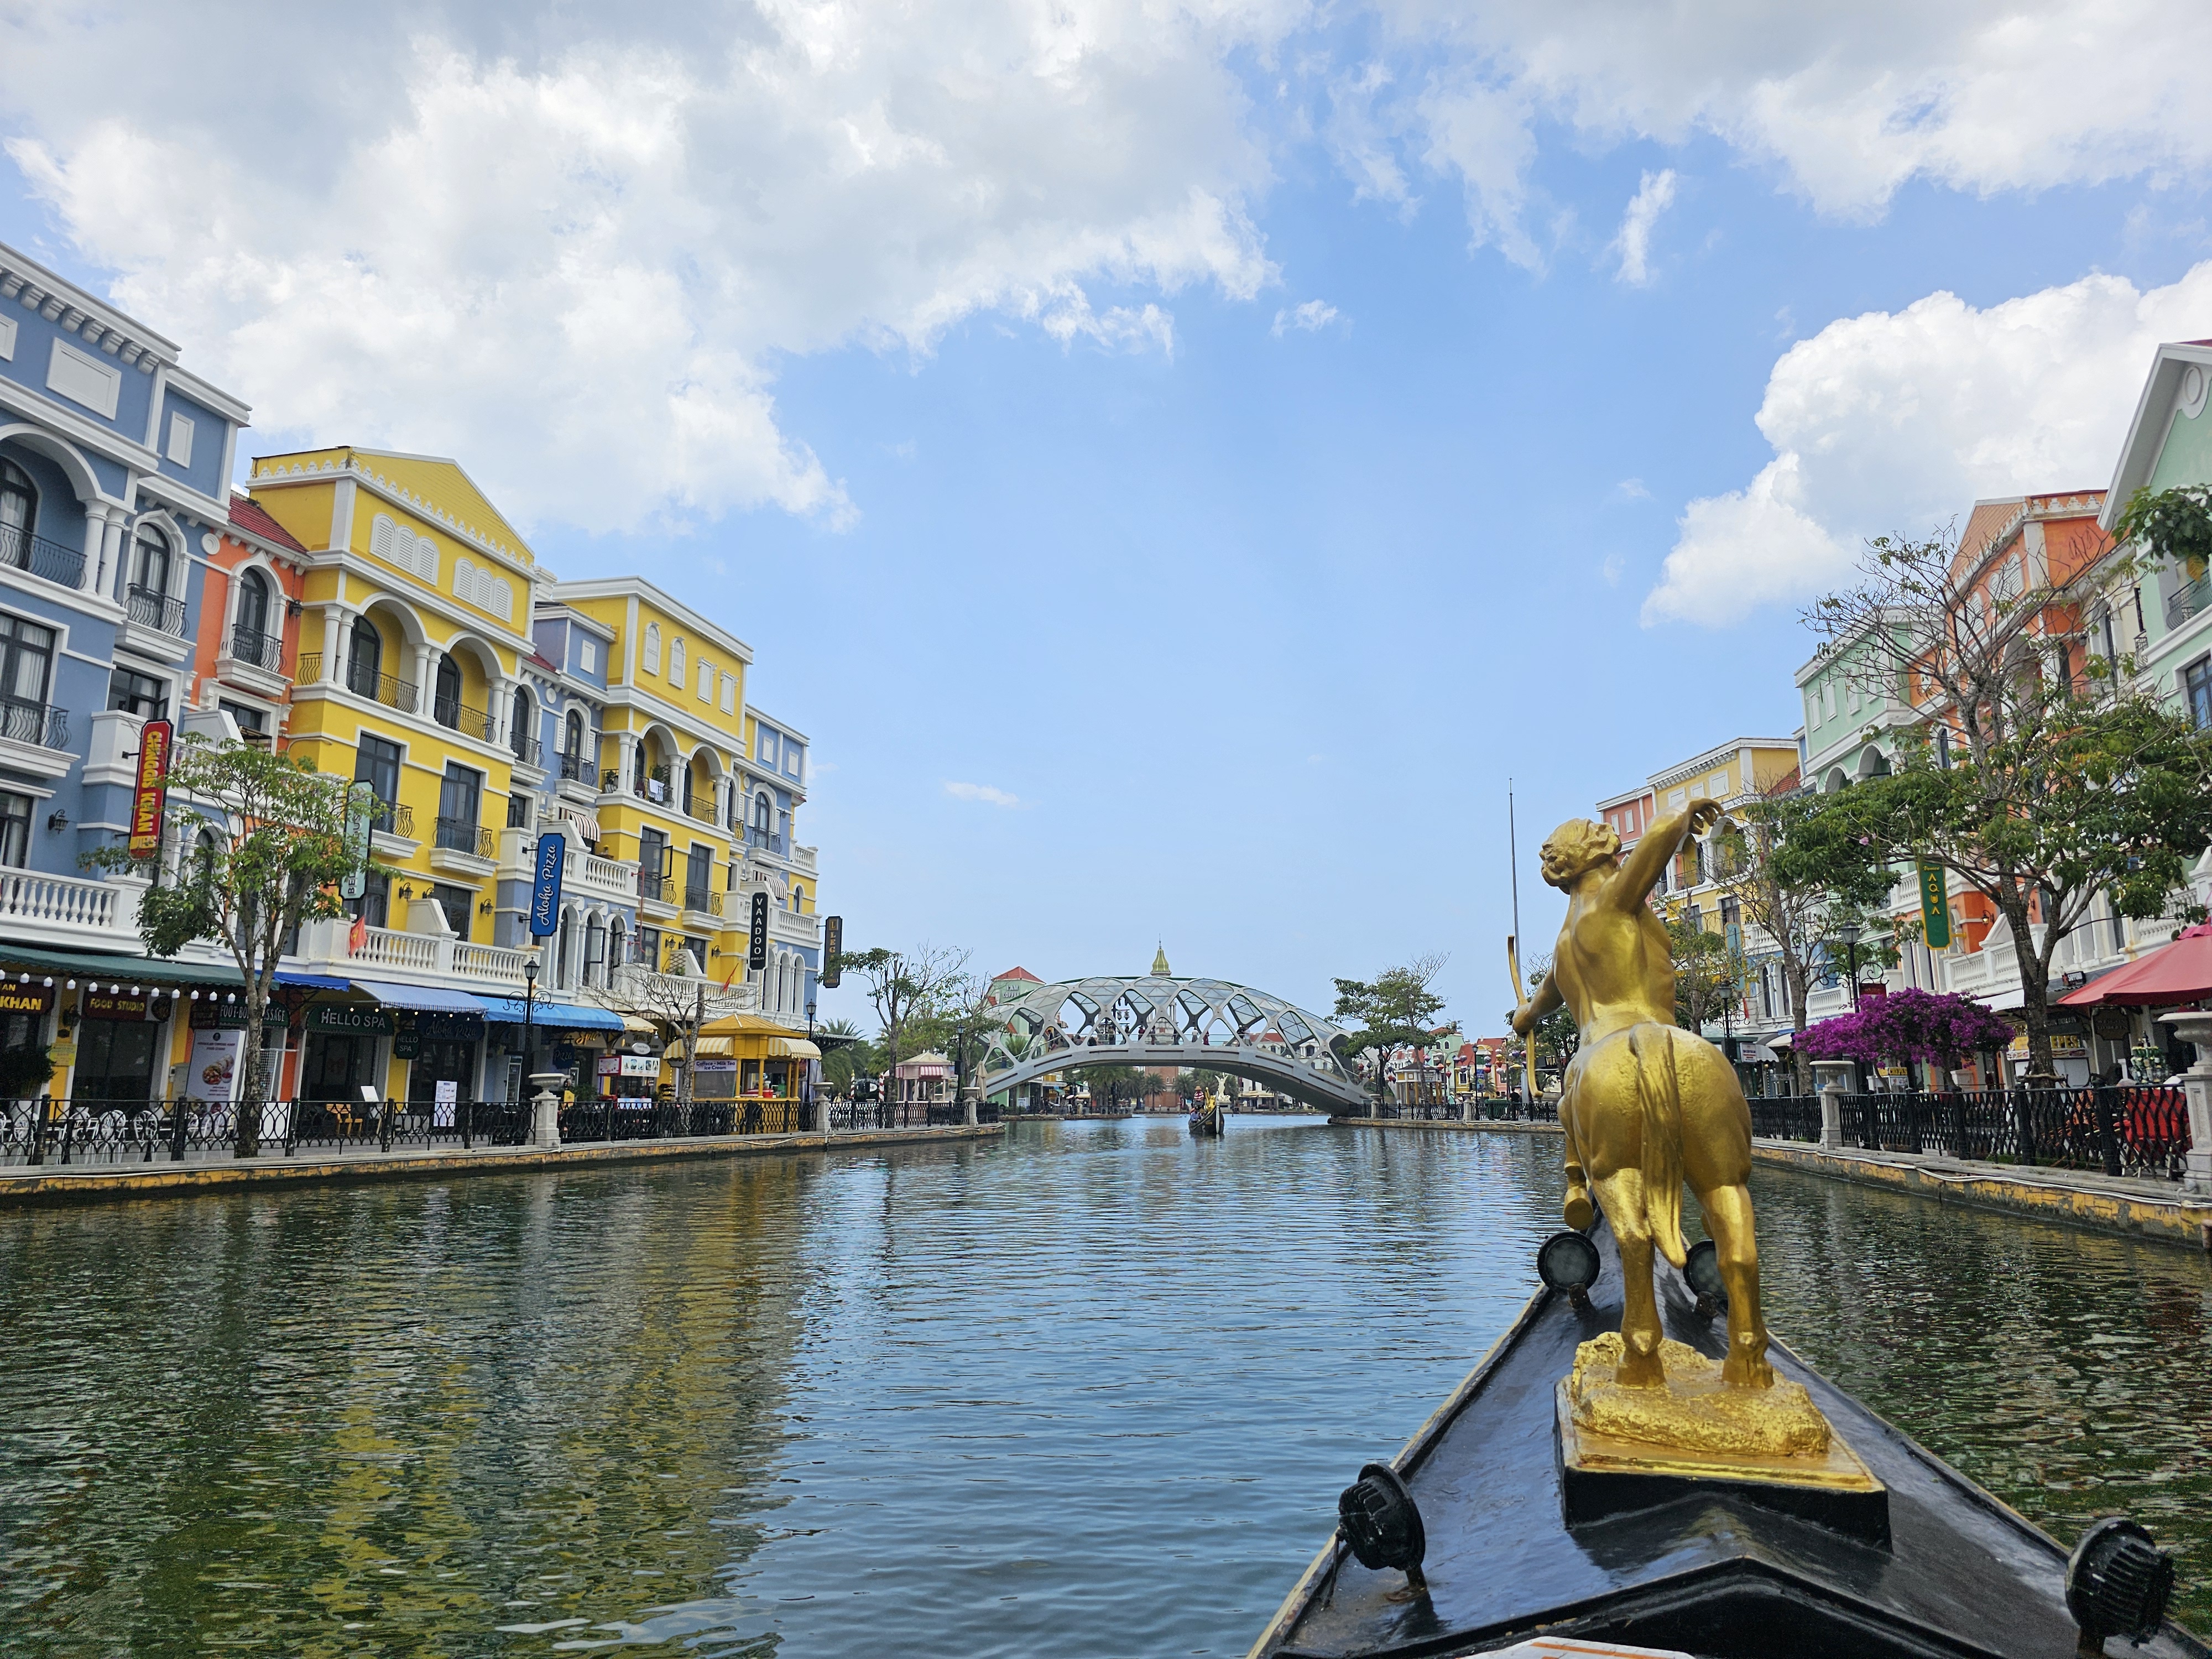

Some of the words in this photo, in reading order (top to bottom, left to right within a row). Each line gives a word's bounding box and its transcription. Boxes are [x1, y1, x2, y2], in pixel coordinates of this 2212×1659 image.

[142, 731, 162, 788] CHINGGIS
[138, 793, 156, 831] KHAN
[542, 843, 557, 880] Pizza
[537, 883, 553, 926] Aloha
[754, 898, 763, 955] VAADOO
[0, 995, 42, 1010] KHAN
[90, 998, 113, 1009] FOOD
[117, 1000, 145, 1012] STUDIO
[220, 1004, 249, 1019] FOOT-BO
[263, 1008, 286, 1022] SSAGE
[321, 1011, 361, 1026] HELLO
[363, 1016, 386, 1029] SPA
[425, 1020, 452, 1037] Aloha
[455, 1024, 477, 1038] Pizza
[397, 1035, 418, 1044] HELLO
[2050, 1035, 2080, 1048] EPES
[554, 1050, 572, 1062] Pizza
